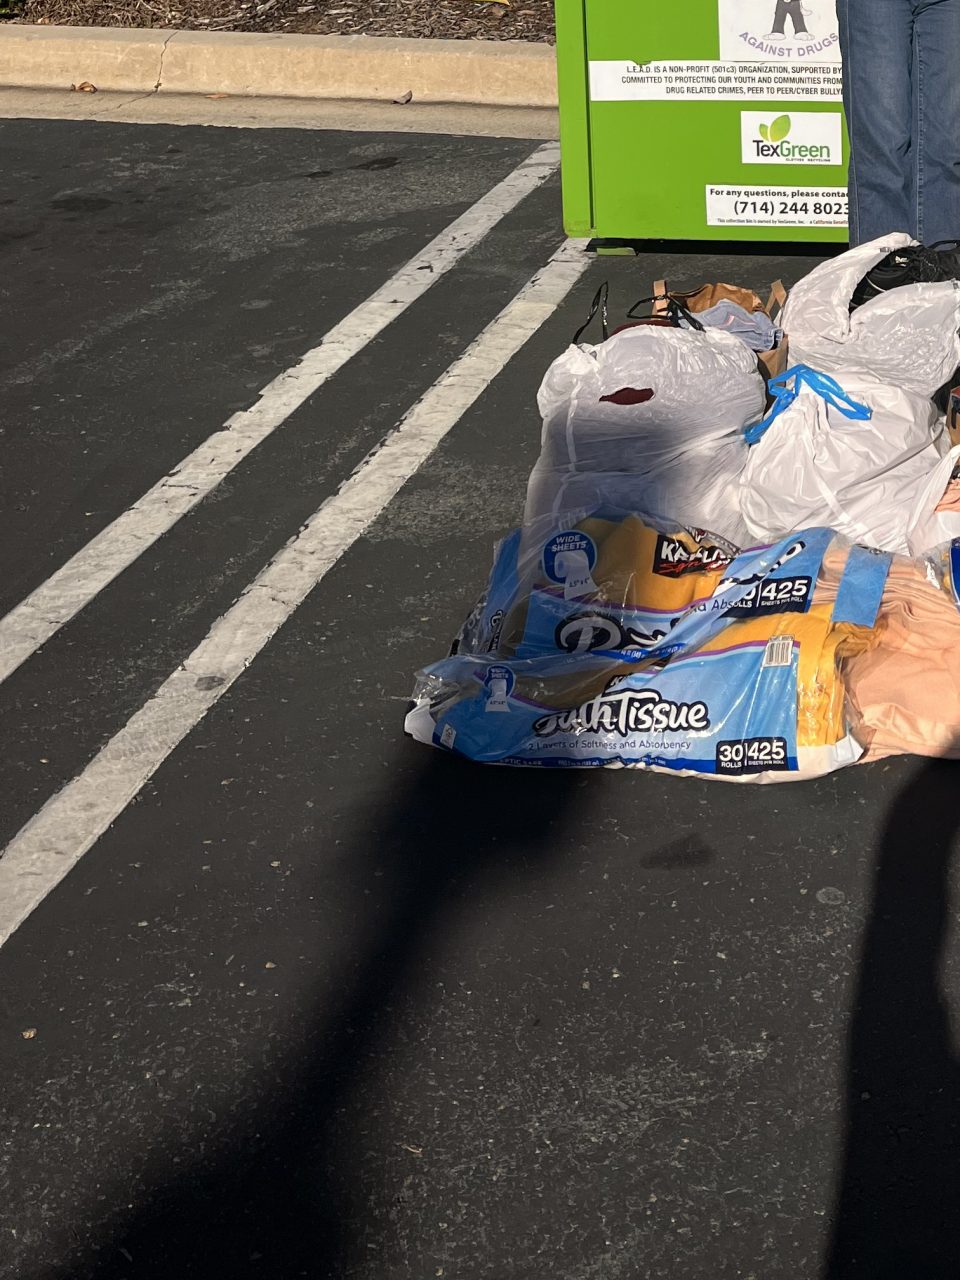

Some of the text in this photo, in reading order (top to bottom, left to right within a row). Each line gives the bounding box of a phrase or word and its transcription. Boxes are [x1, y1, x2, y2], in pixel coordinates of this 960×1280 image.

[739, 31, 840, 58] AGAINST DRUGS
[712, 66, 737, 74] (501c3)
[738, 66, 790, 74] ORGANIZATION,
[791, 66, 831, 74] SUPPORTED
[621, 76, 662, 84] COMMITTED
[674, 76, 717, 84] PROTECTING
[718, 76, 732, 84] OUR
[734, 76, 756, 84] YOUTH
[666, 86, 685, 94] DRUG
[718, 87, 746, 95] CRIMES,
[776, 87, 818, 95] PEER/CYBER
[752, 140, 831, 158] TexGreen
[744, 189, 789, 198] questions,
[791, 190, 819, 198] please
[734, 201, 775, 216] (714)
[779, 202, 809, 214] 244
[555, 534, 580, 544] WIDE
[551, 541, 588, 552] SHEETS
[762, 579, 808, 600] 425
[736, 600, 752, 608] OLLS
[602, 690, 708, 734] Tissue
[569, 740, 579, 748] of
[619, 740, 636, 749] and
[638, 740, 691, 750] Absorbency
[719, 741, 785, 761] 30 425
